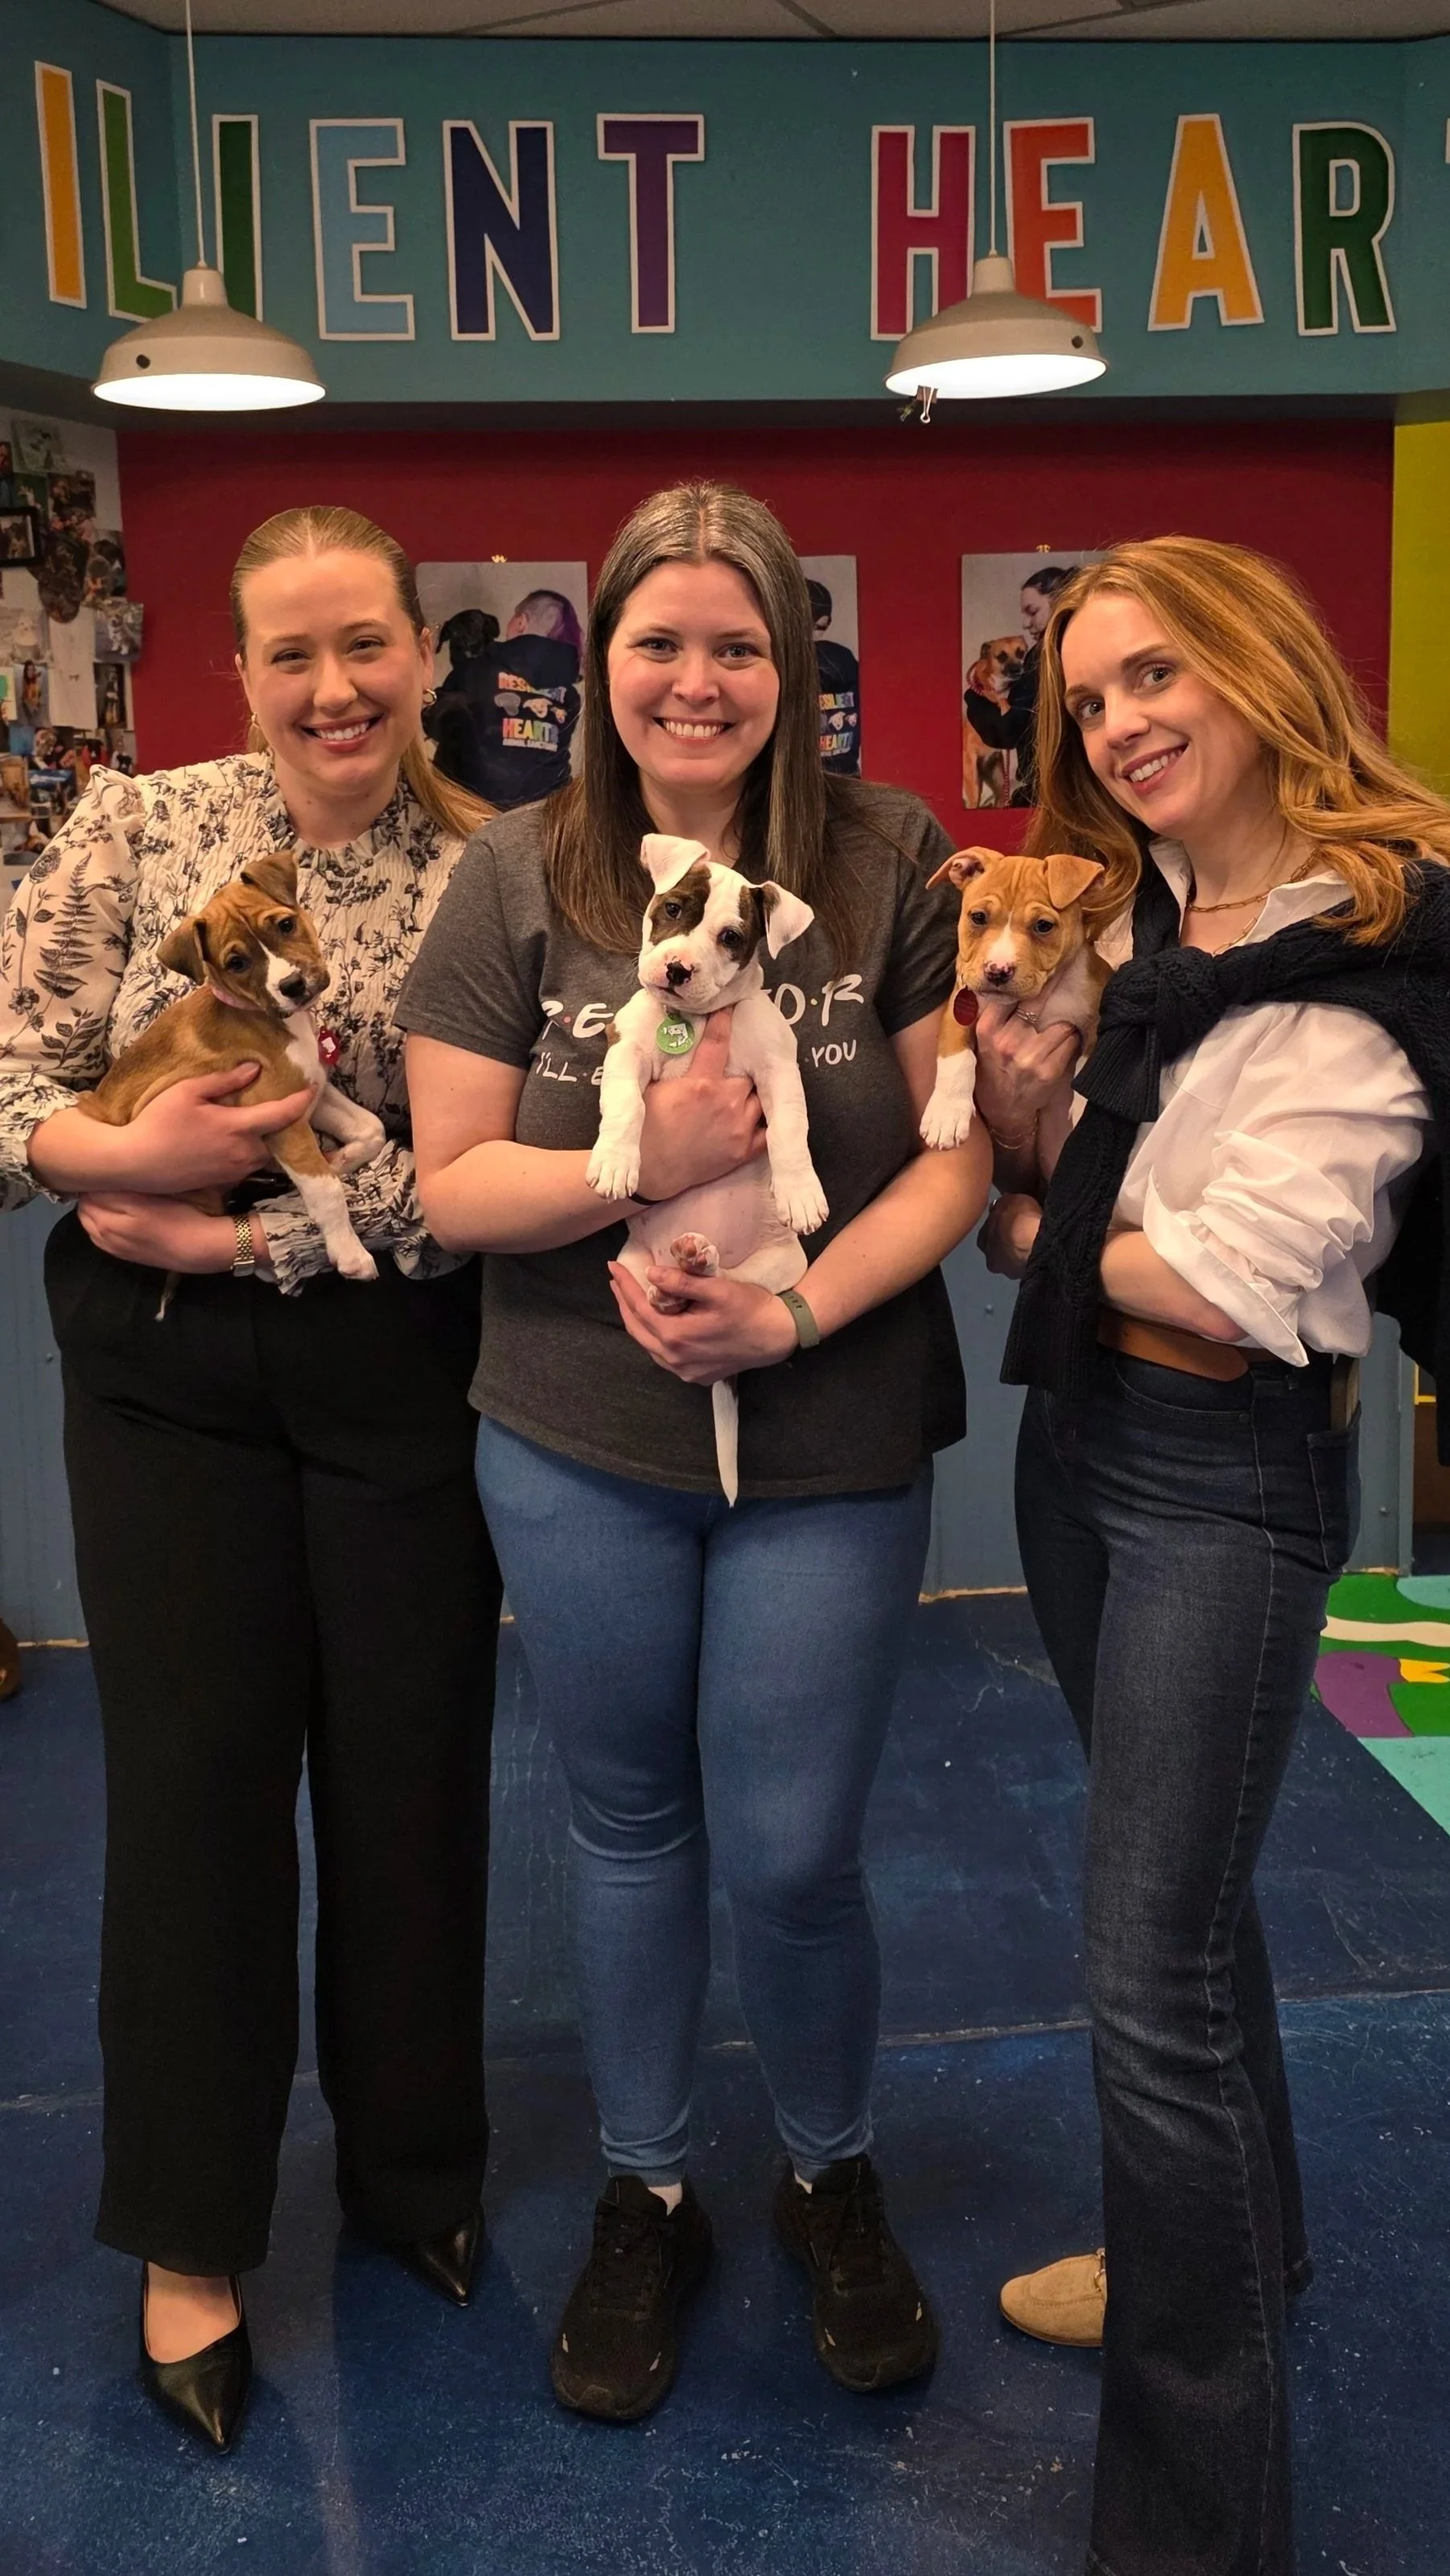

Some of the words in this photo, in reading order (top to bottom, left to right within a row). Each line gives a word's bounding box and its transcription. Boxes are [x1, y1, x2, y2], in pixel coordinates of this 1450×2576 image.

[871, 113, 1450, 342] HEAR
[536, 1052, 578, 1082] I'LL
[811, 1039, 857, 1068] YOU
